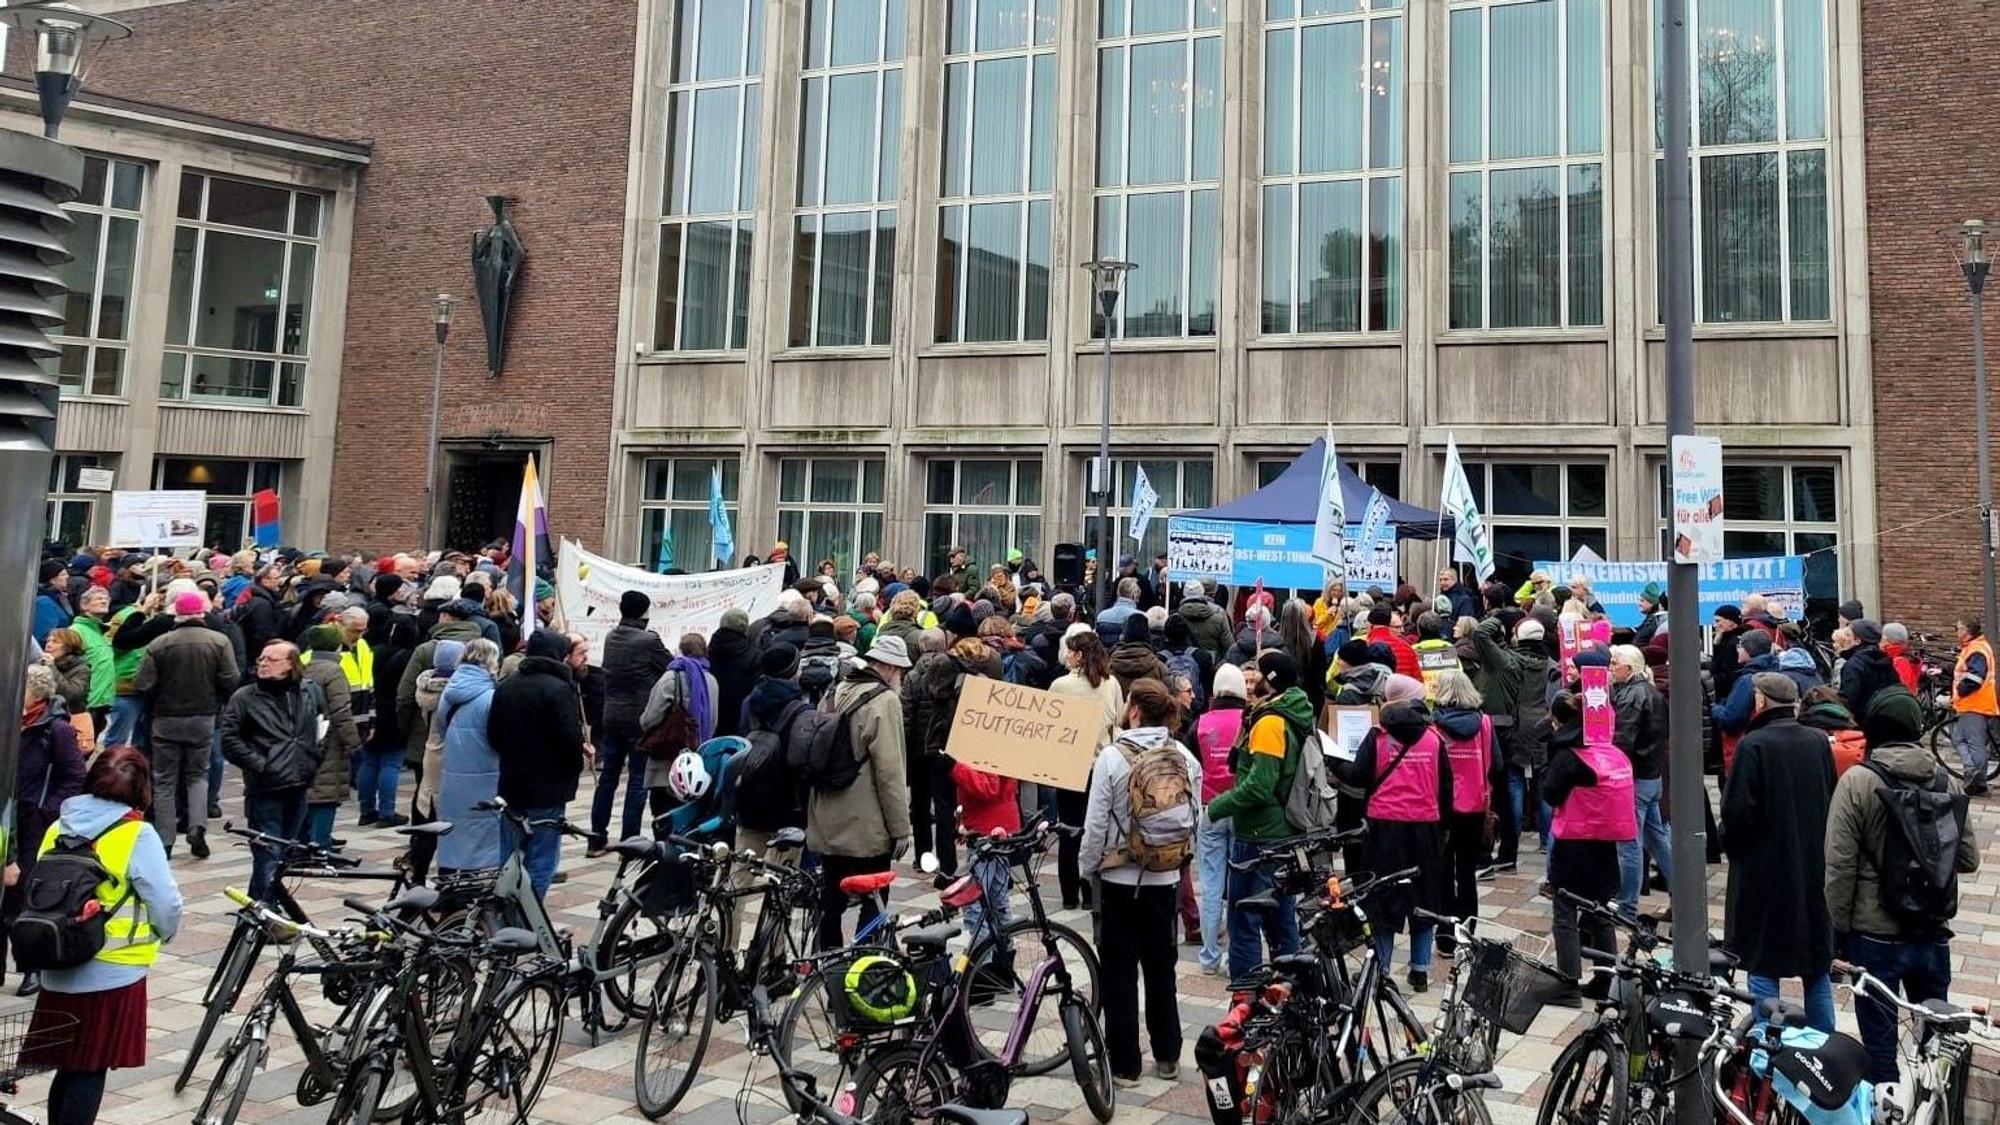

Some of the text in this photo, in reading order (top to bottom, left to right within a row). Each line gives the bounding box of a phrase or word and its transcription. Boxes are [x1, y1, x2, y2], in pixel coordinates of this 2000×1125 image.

[1676, 488, 1698, 504] Free
[1677, 509, 1690, 523] für
[987, 684, 1065, 718] KÖLNS
[961, 709, 1078, 746] STUTTGART 21
[1660, 1001, 1704, 1017] DOORDASH
[1795, 1051, 1834, 1092] DOORDASH
